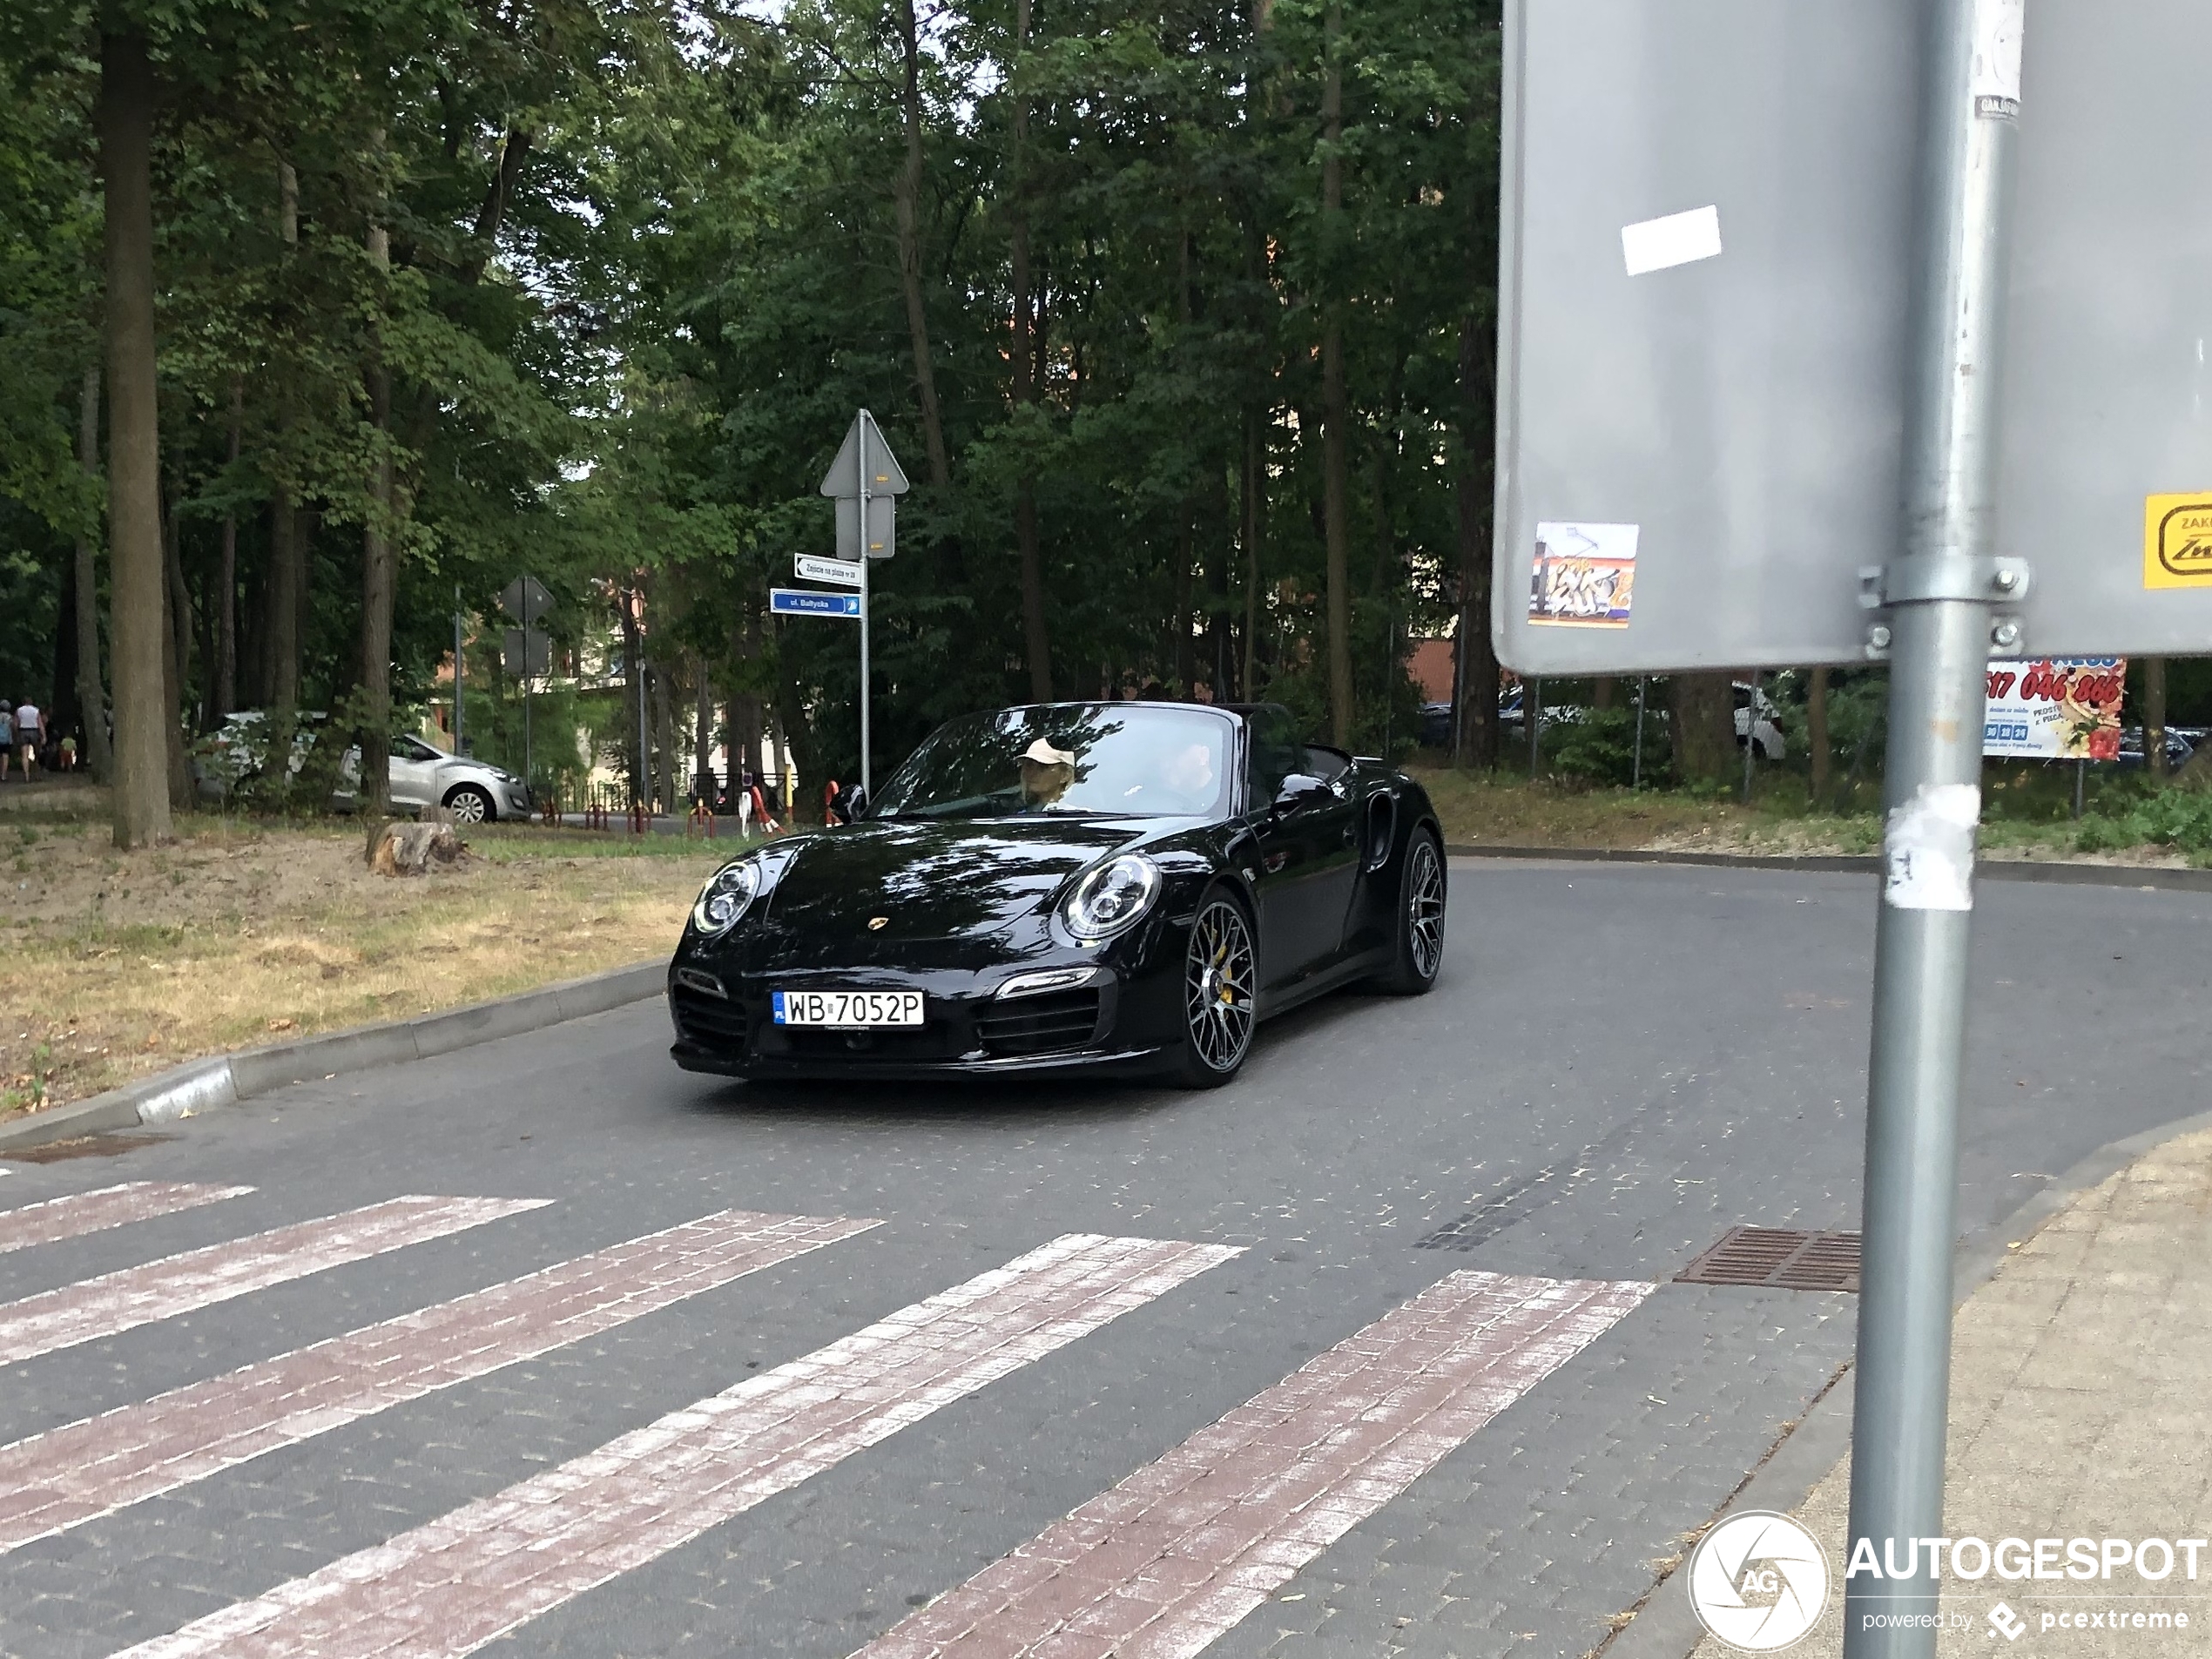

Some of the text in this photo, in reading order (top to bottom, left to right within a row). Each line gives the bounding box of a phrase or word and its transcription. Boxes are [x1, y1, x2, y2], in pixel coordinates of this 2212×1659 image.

[2182, 517, 2212, 529] ZAK
[800, 599, 829, 609] Bałtycka
[2020, 671, 2068, 701] 046
[2073, 674, 2121, 703] 866
[789, 995, 919, 1022] WB 7052P
